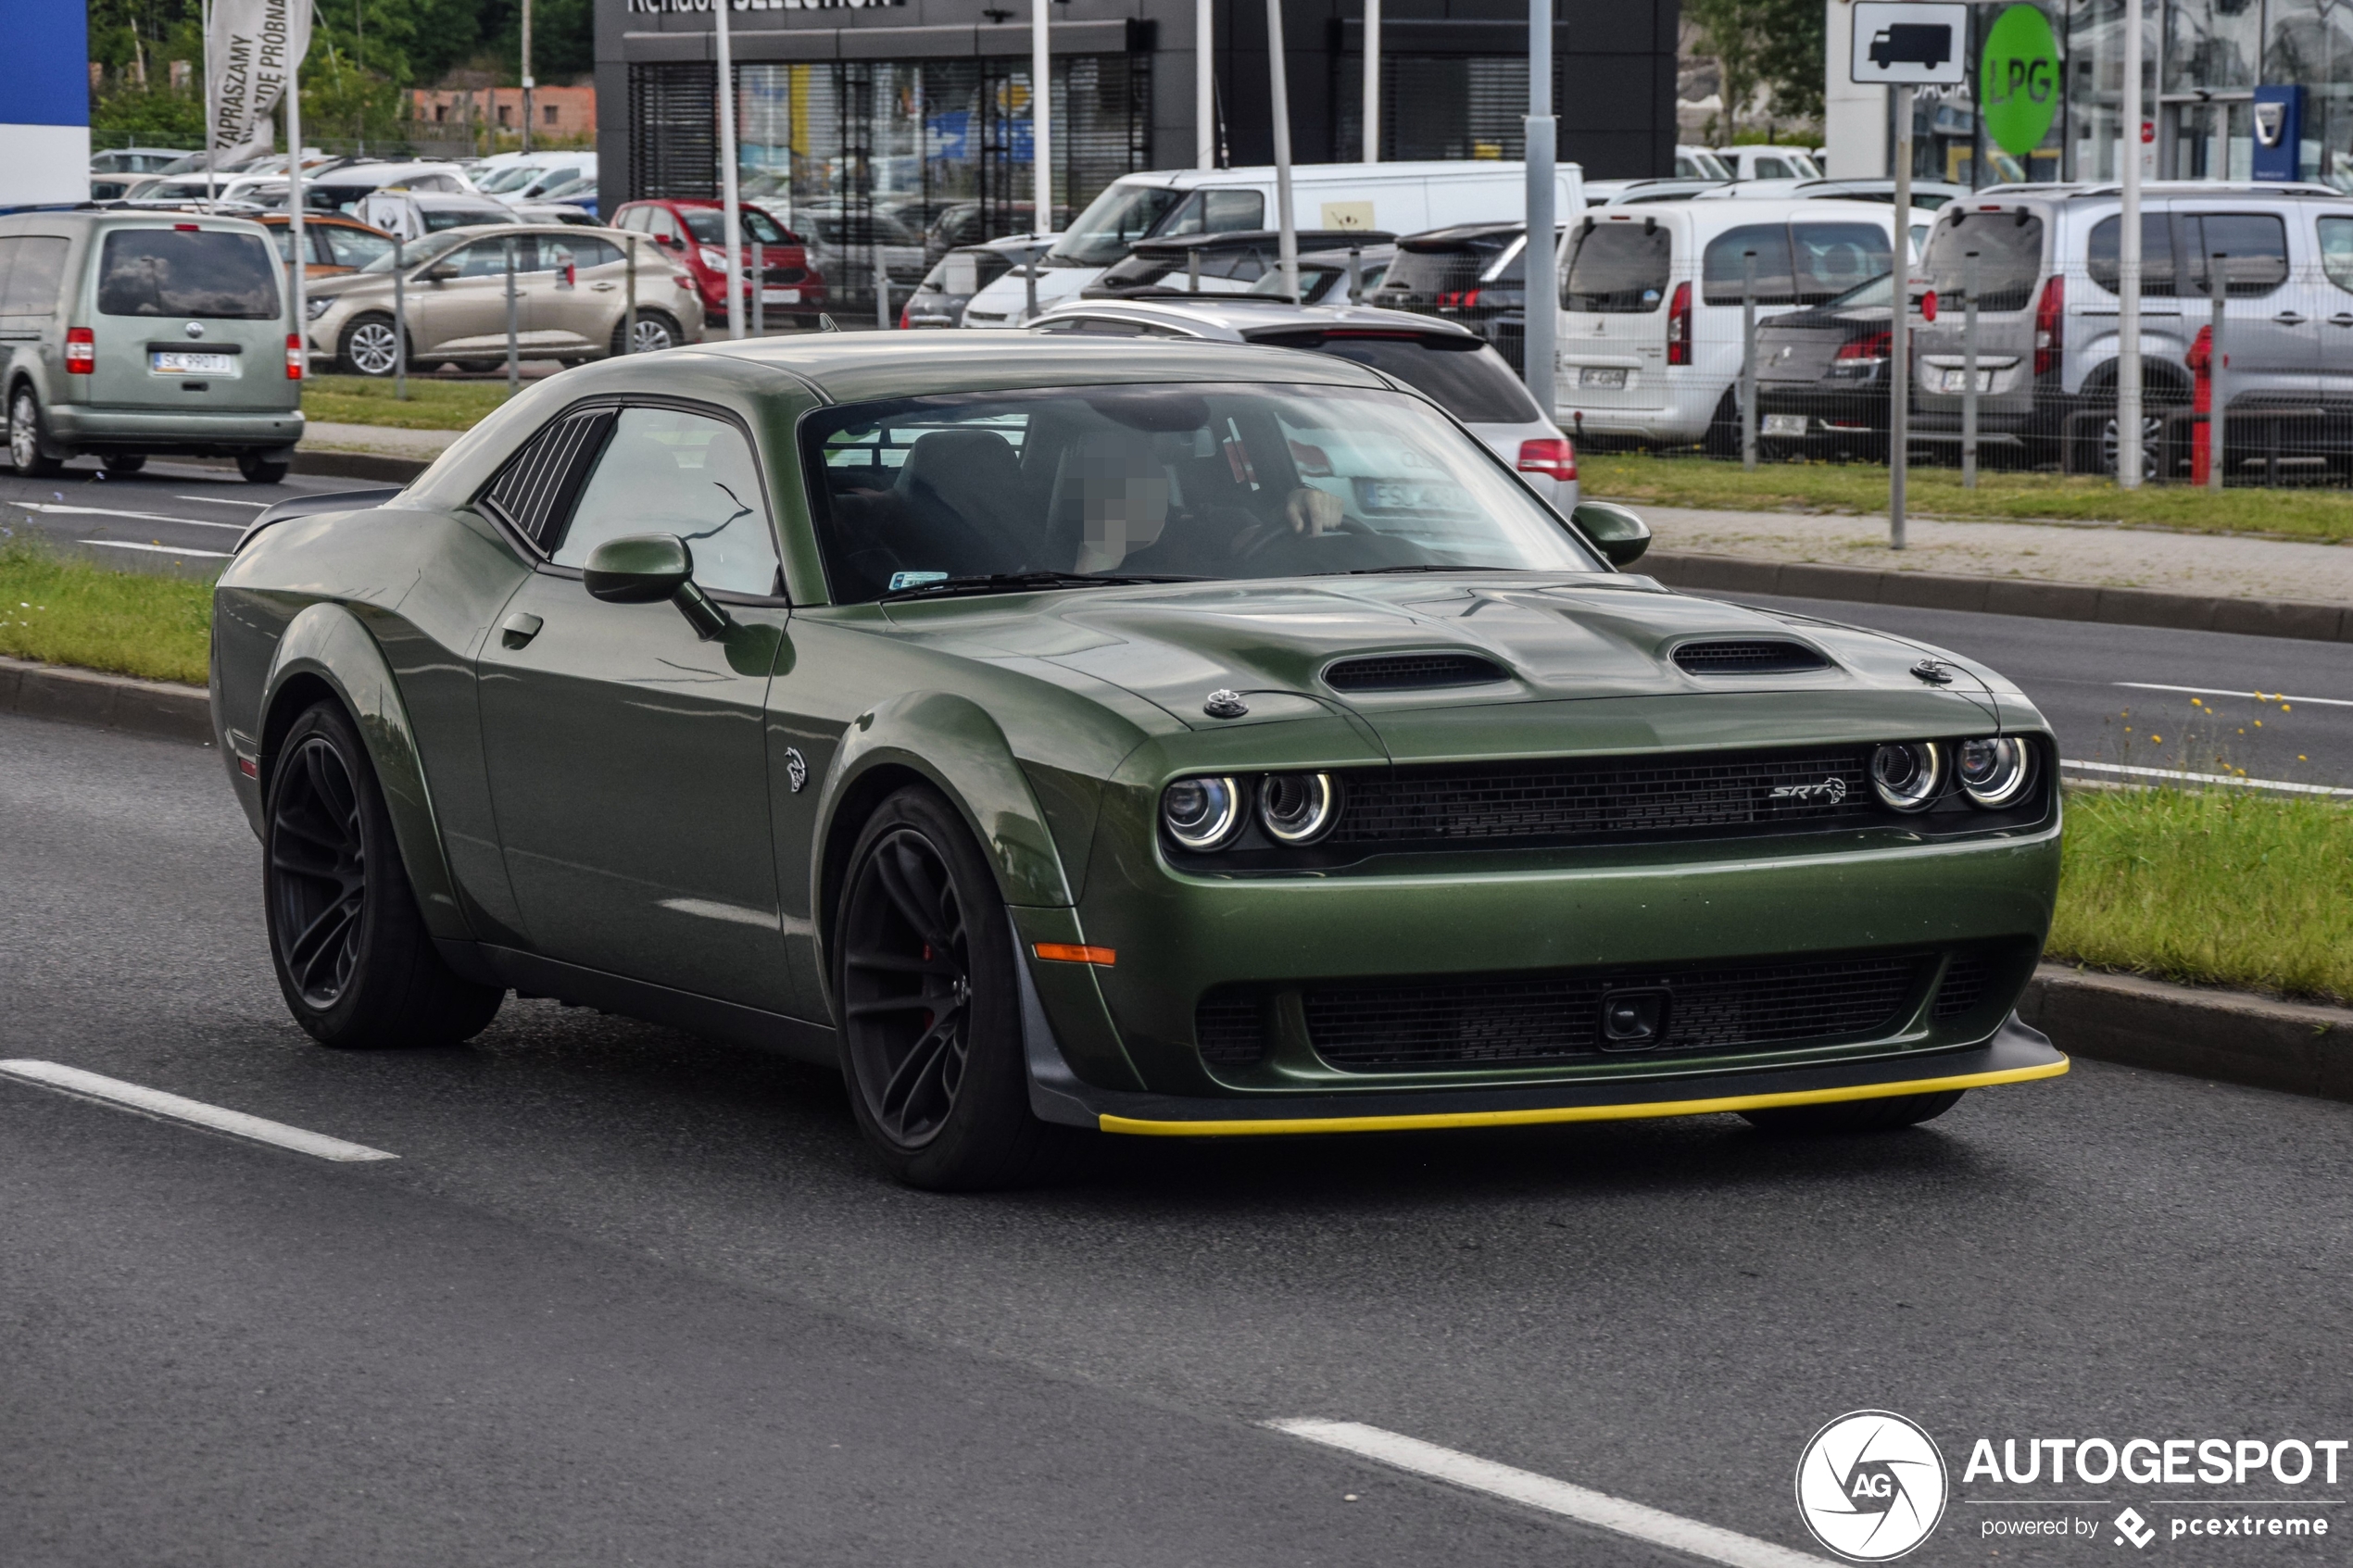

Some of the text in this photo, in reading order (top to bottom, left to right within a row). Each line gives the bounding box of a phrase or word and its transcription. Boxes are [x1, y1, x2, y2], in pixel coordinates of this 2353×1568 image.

[214, 34, 253, 150] ZAPRASZAMY
[1990, 57, 2051, 105] LPG
[1768, 784, 1831, 800] SRT
